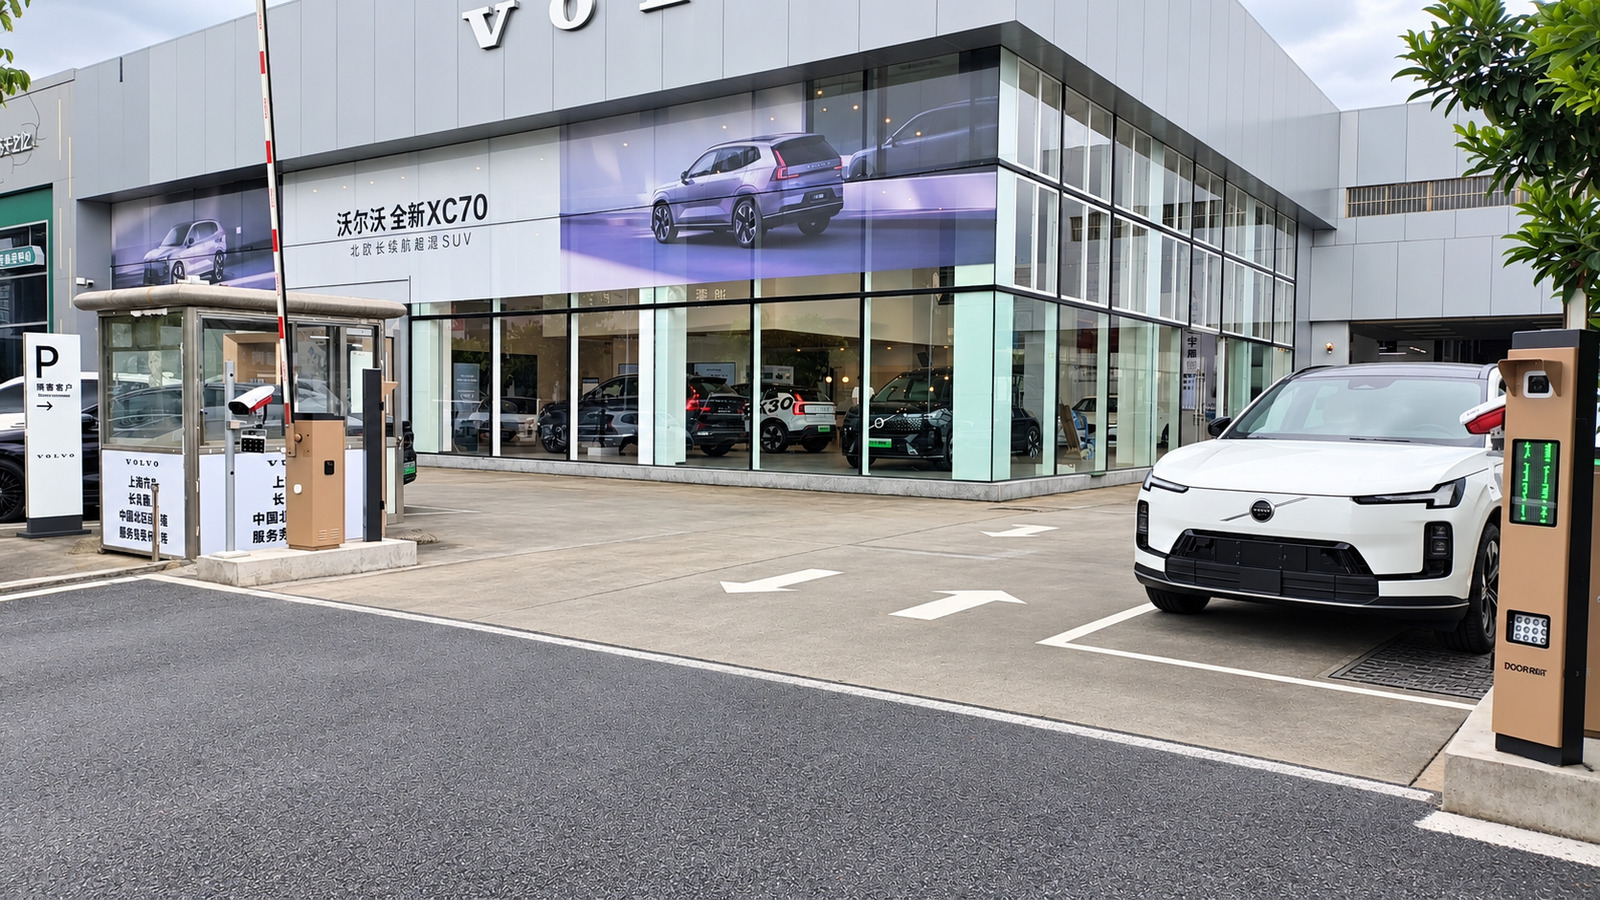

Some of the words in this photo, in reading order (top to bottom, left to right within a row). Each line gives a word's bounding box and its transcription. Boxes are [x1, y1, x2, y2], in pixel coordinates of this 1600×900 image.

[336, 206, 387, 237] 沃尔沃
[390, 193, 488, 231] 全新XC70
[36, 345, 59, 378] P
[125, 459, 159, 467] VOLVO
